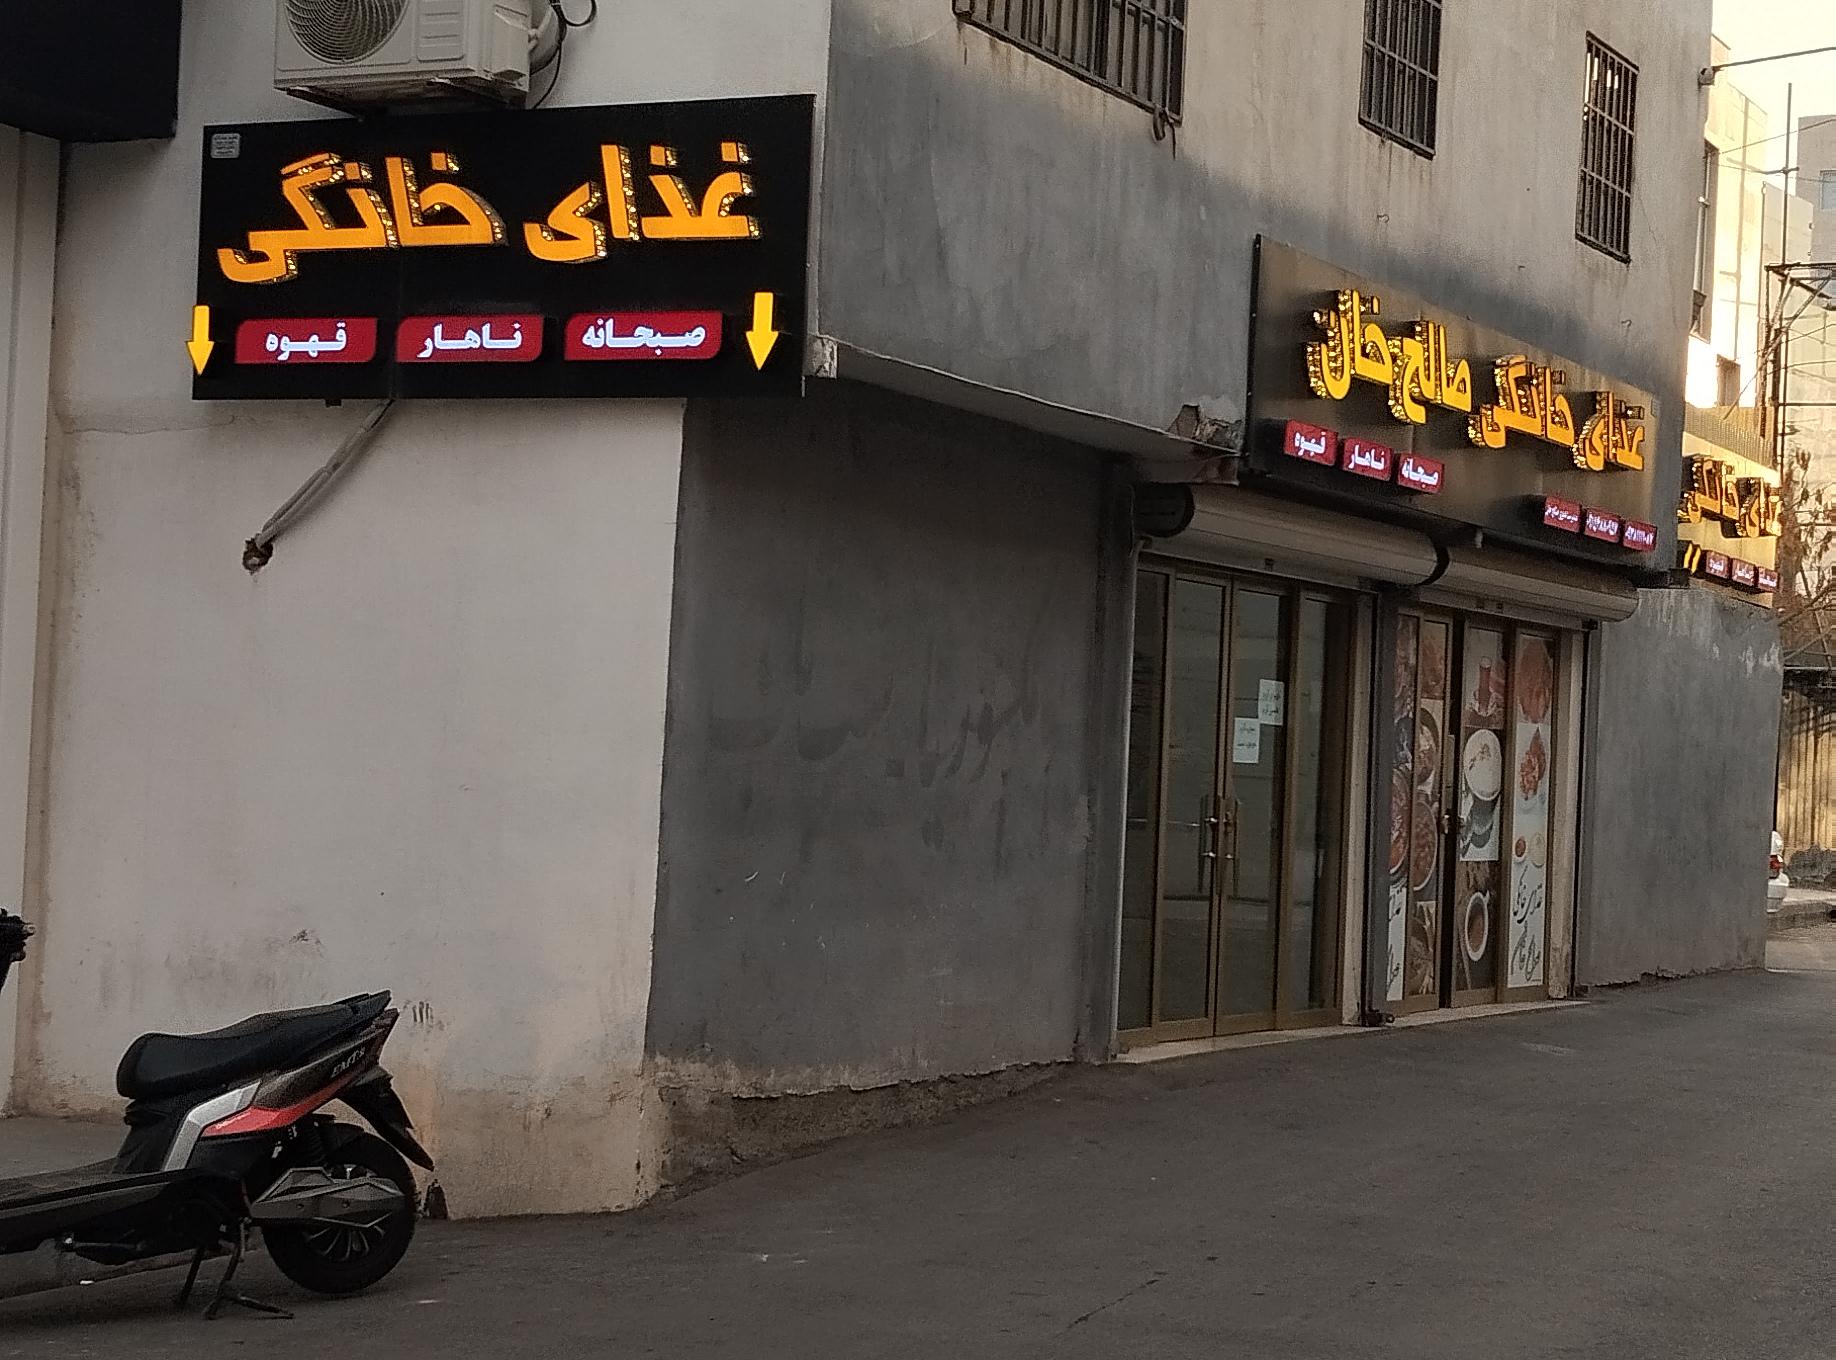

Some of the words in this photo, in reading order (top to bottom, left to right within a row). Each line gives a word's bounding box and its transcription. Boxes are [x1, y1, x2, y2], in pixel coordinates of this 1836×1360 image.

[217, 151, 508, 284] خانگی
[523, 141, 763, 264] غذای
[264, 322, 349, 361] قهوه
[416, 321, 523, 358] ناهار
[580, 318, 707, 354] صبحانه
[1307, 288, 1393, 401] خان
[1388, 320, 1473, 425] صالح
[1467, 353, 1575, 449] خانگی
[1573, 390, 1646, 472] غذای
[1294, 431, 1327, 458] قهوه
[1348, 443, 1386, 471] ناهار
